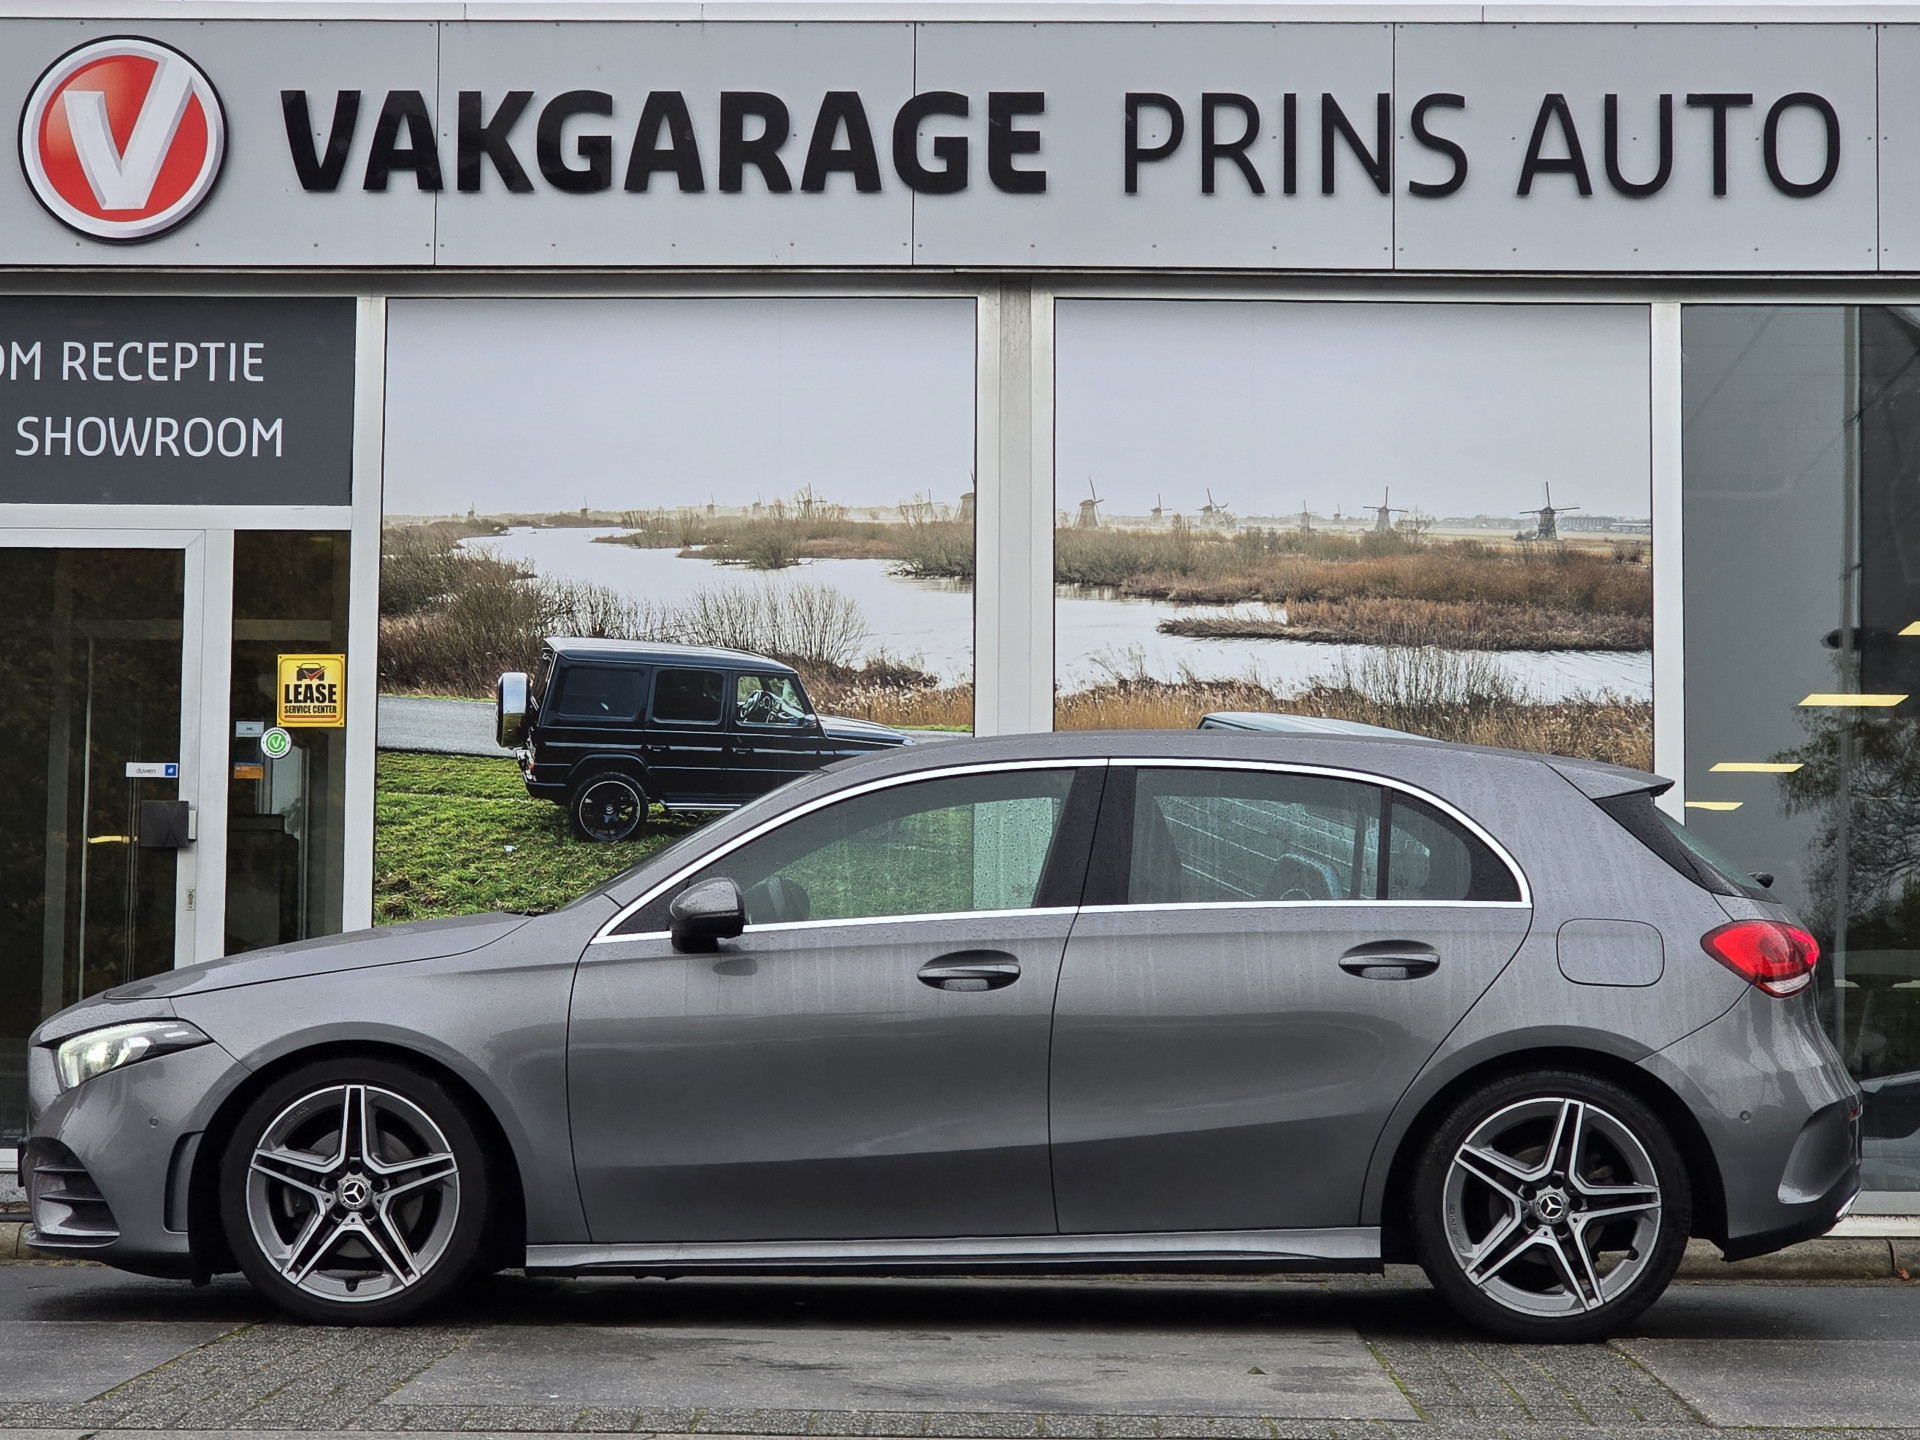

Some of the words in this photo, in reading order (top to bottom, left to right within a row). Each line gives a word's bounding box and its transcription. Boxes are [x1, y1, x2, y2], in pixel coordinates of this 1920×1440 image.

[281, 90, 1047, 194] VAKGARAGE
[1124, 92, 1469, 198] PRINS
[1516, 92, 1841, 199] AUTO
[0, 341, 42, 381] M
[62, 341, 265, 382] RECEPTIE
[15, 416, 283, 458] SHOWROOM
[284, 683, 337, 704] LEASE
[284, 704, 311, 714] SERVICE
[312, 704, 337, 714] CENTER
